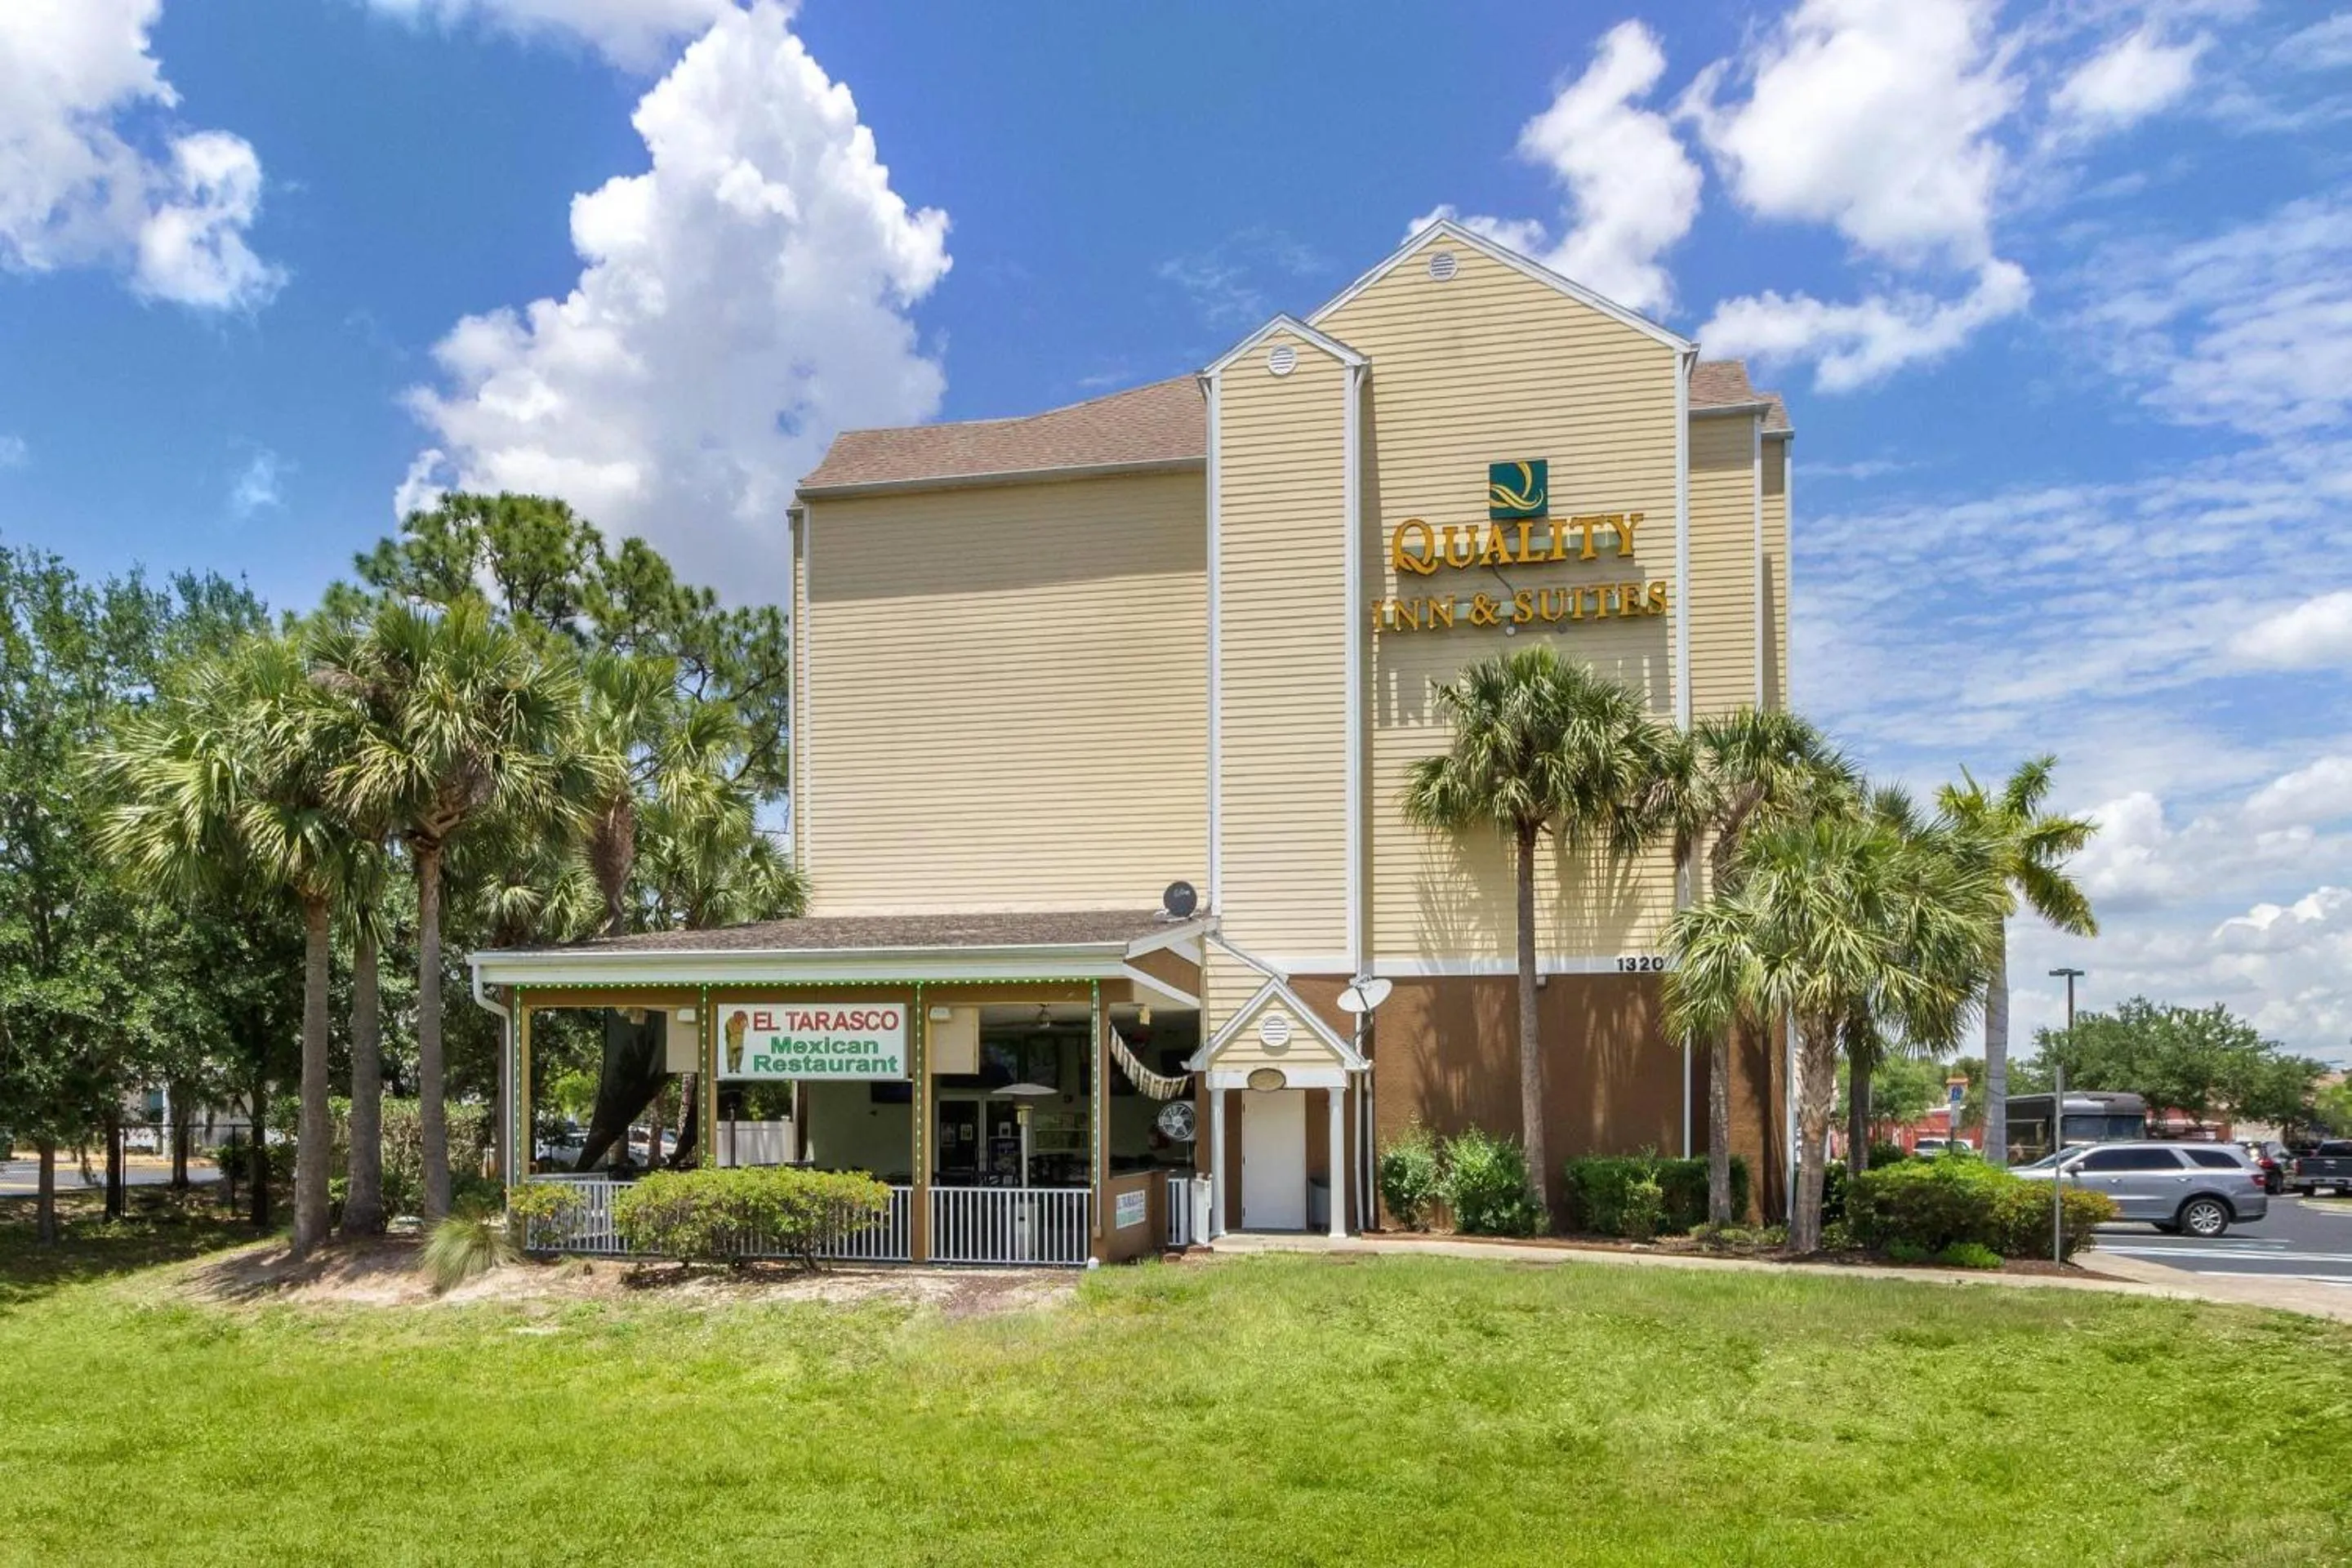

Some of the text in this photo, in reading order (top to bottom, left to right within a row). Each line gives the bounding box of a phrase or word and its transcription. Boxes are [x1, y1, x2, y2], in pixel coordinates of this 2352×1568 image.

[1392, 513, 1644, 575] QUALITY
[1372, 581, 1668, 634] INN & SUITES
[1617, 956, 1664, 971] 1320
[753, 1010, 899, 1031] EL TARASCO
[771, 1036, 879, 1055] Mexican
[754, 1054, 898, 1073] Restaurant
